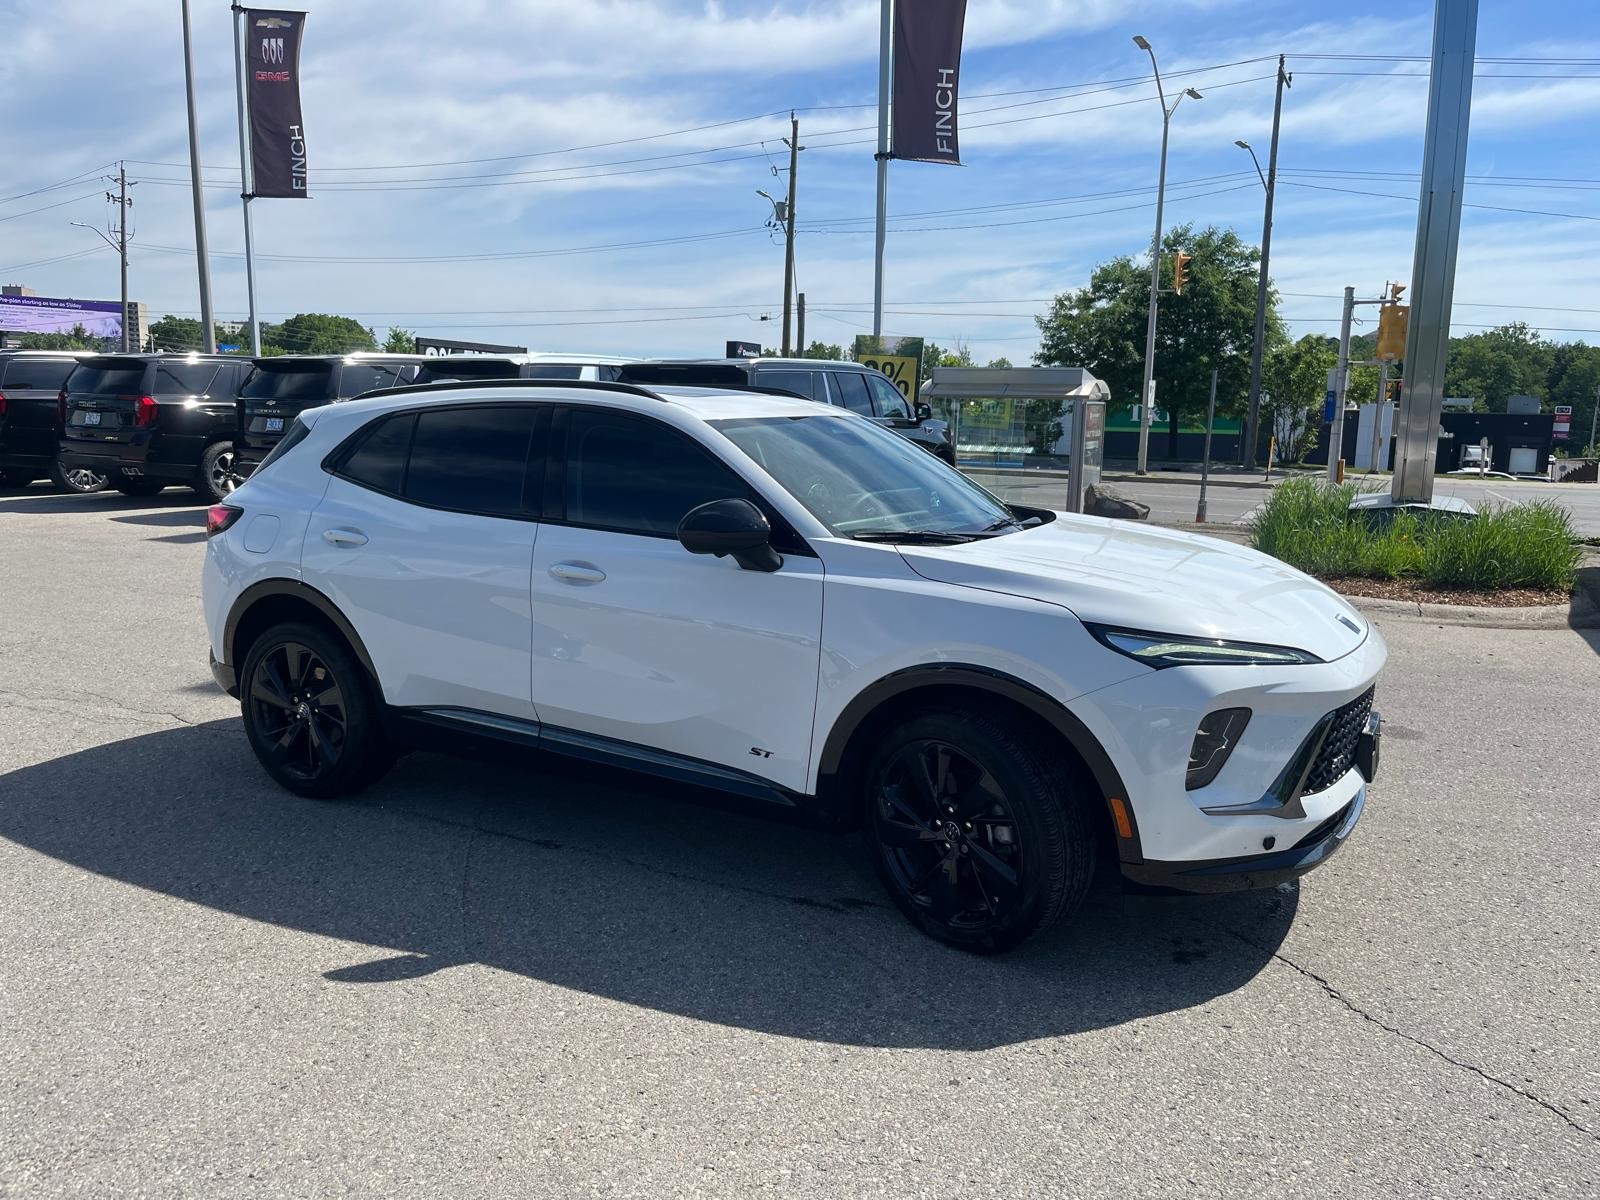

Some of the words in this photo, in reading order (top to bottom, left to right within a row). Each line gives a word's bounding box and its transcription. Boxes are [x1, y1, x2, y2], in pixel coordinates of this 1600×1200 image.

[255, 70, 290, 82] GMC
[935, 68, 954, 154] FINCH
[289, 124, 306, 191] FINCH
[749, 747, 775, 758] ST
